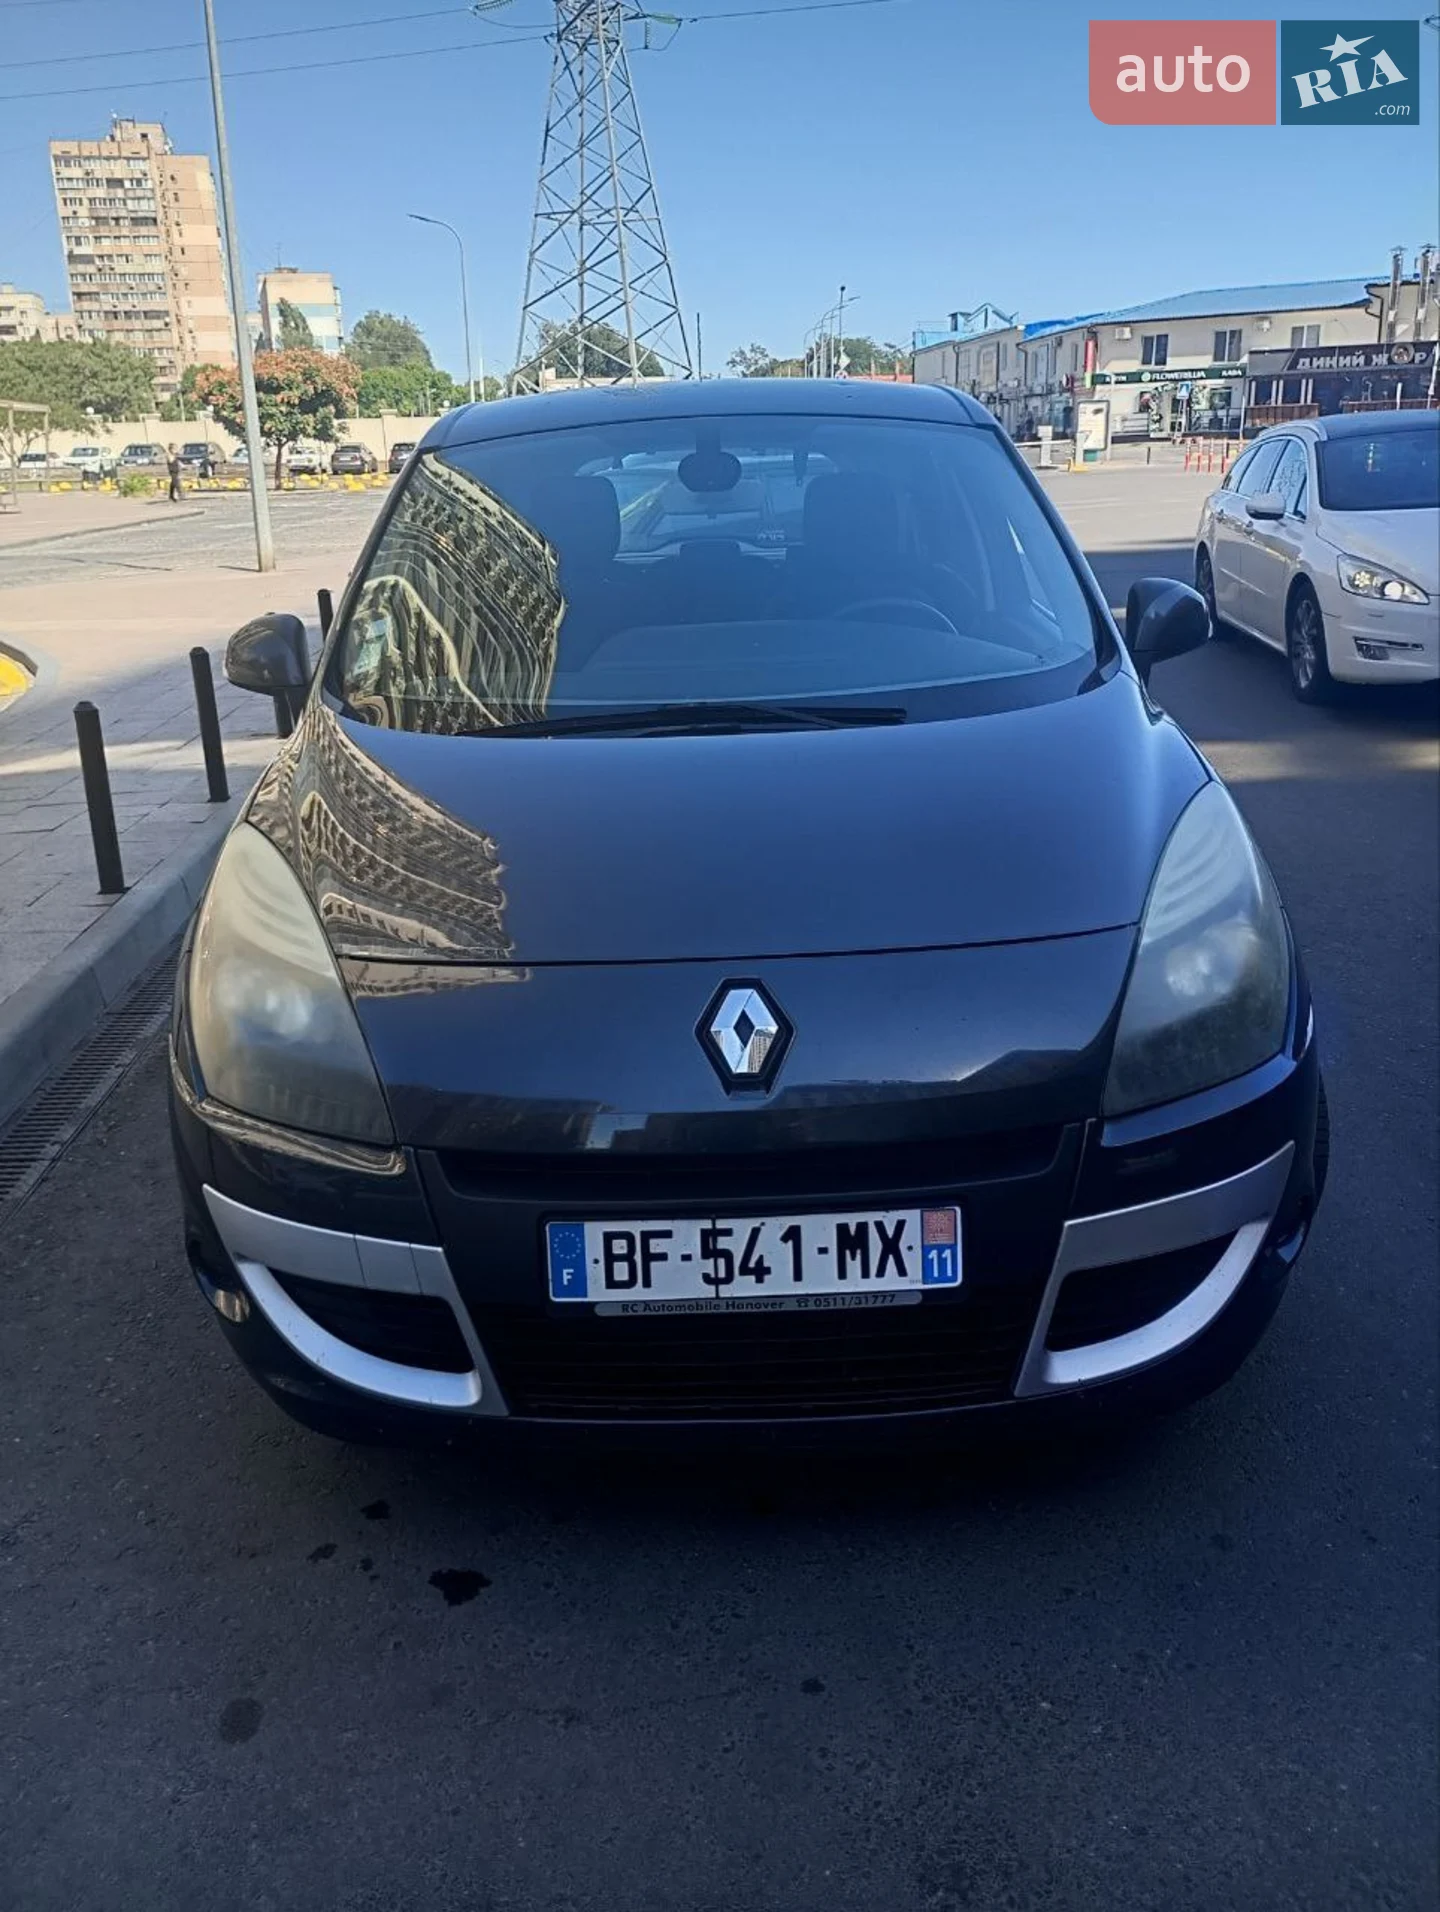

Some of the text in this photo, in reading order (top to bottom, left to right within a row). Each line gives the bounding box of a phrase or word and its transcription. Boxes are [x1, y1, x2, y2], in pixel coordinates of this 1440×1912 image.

[602, 1219, 908, 1290] BF-541-MX
[928, 1248, 953, 1277] 11
[562, 1269, 574, 1286] F
[621, 1303, 640, 1314] RC
[643, 1300, 721, 1313] Automobile
[725, 1299, 786, 1312] Hanover
